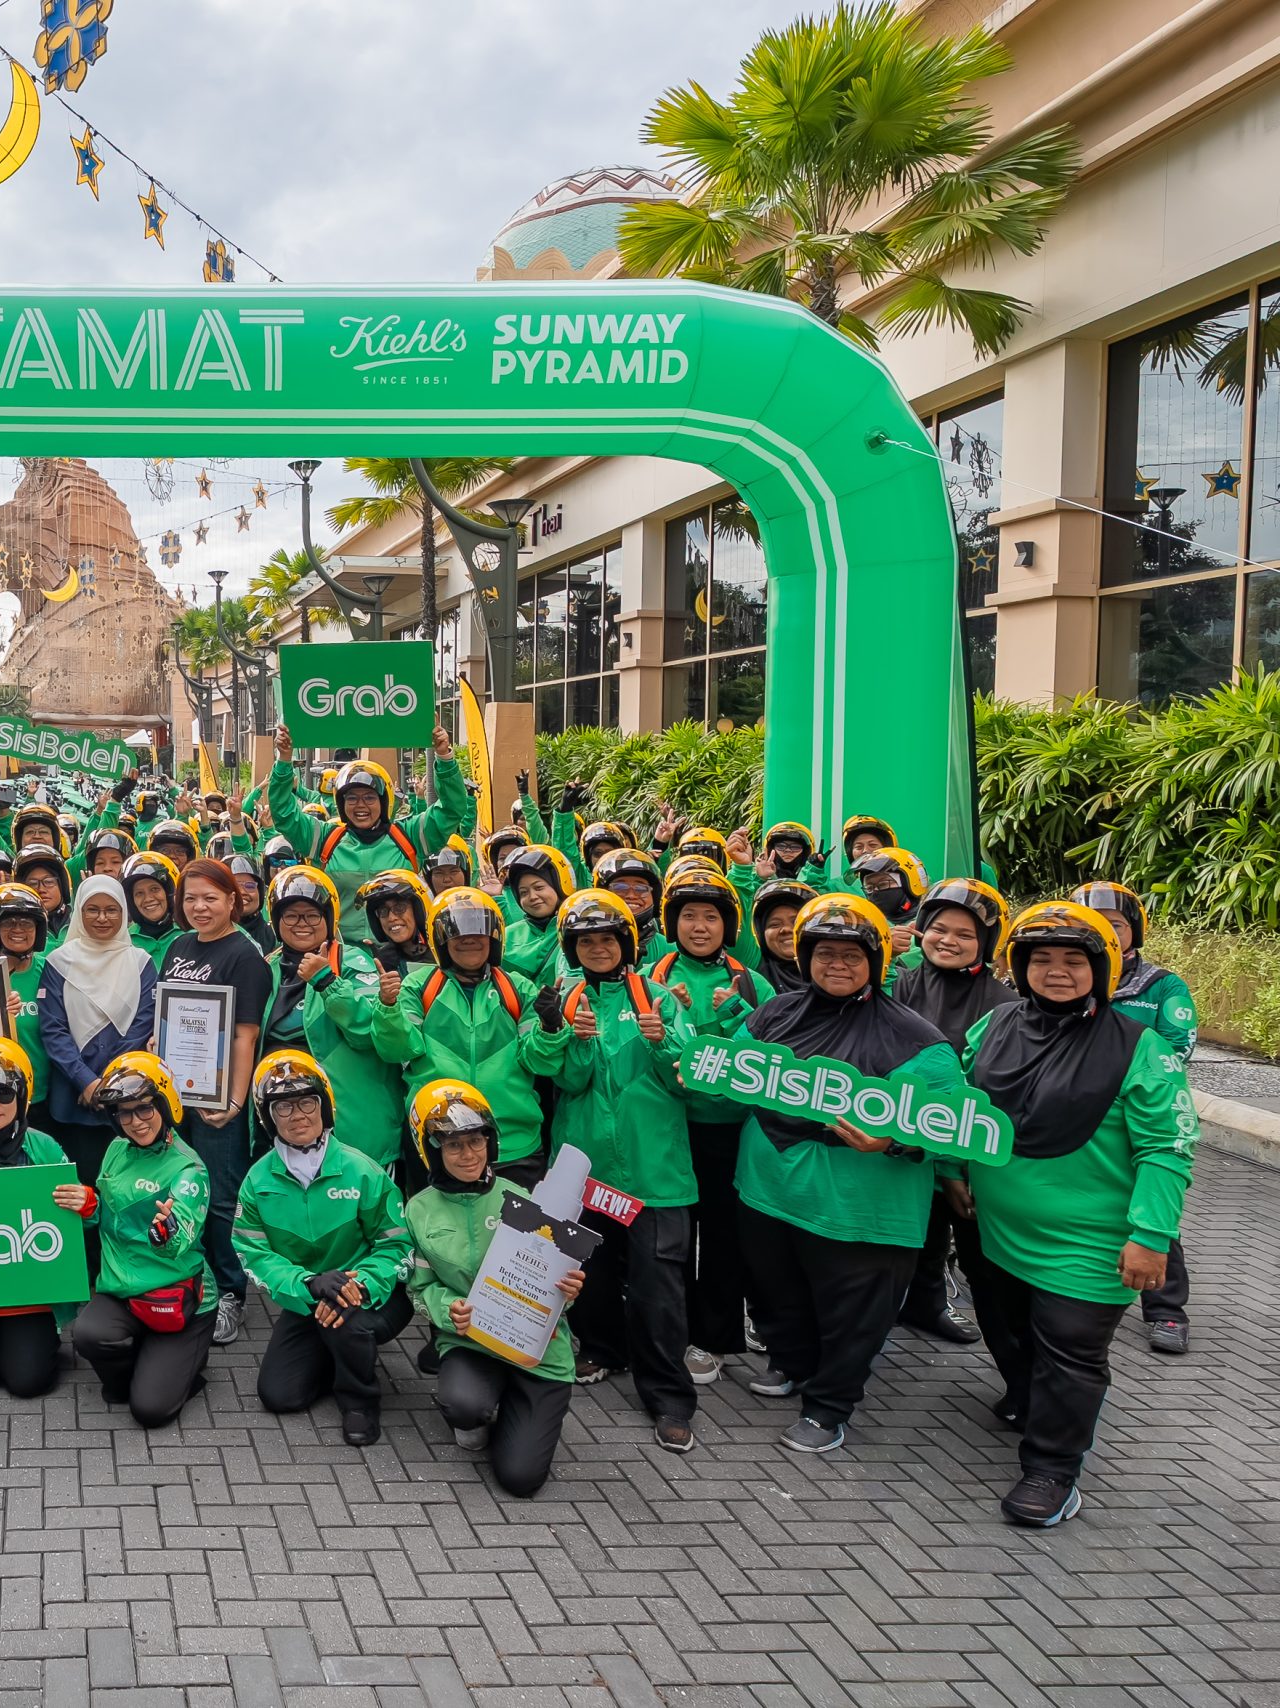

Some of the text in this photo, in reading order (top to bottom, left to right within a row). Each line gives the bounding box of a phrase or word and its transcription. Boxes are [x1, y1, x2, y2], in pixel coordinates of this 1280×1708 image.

[329, 316, 467, 358] Kiehl's
[492, 313, 686, 345] SUNWAY
[491, 349, 689, 384] PYRAMID
[362, 376, 449, 385] SINCE 1851
[528, 504, 562, 546] Thai
[298, 674, 418, 717] Grab
[180, 1018, 206, 1026] MALAYSIA
[1174, 1007, 1192, 1021] 67
[1158, 1054, 1183, 1073] 30
[689, 1045, 1000, 1155] #SisBoleh
[135, 1178, 160, 1193] Grab
[180, 1180, 200, 1198] 29
[327, 1186, 361, 1200] Grab
[590, 1185, 632, 1220] NEW!
[515, 1251, 549, 1272] KIEHL'S
[498, 1267, 549, 1296] Better Screen
[500, 1276, 540, 1301] UV Serum
[477, 1321, 487, 1329] 1.7
[508, 1336, 516, 1344] 50
[516, 1341, 525, 1349] ml
